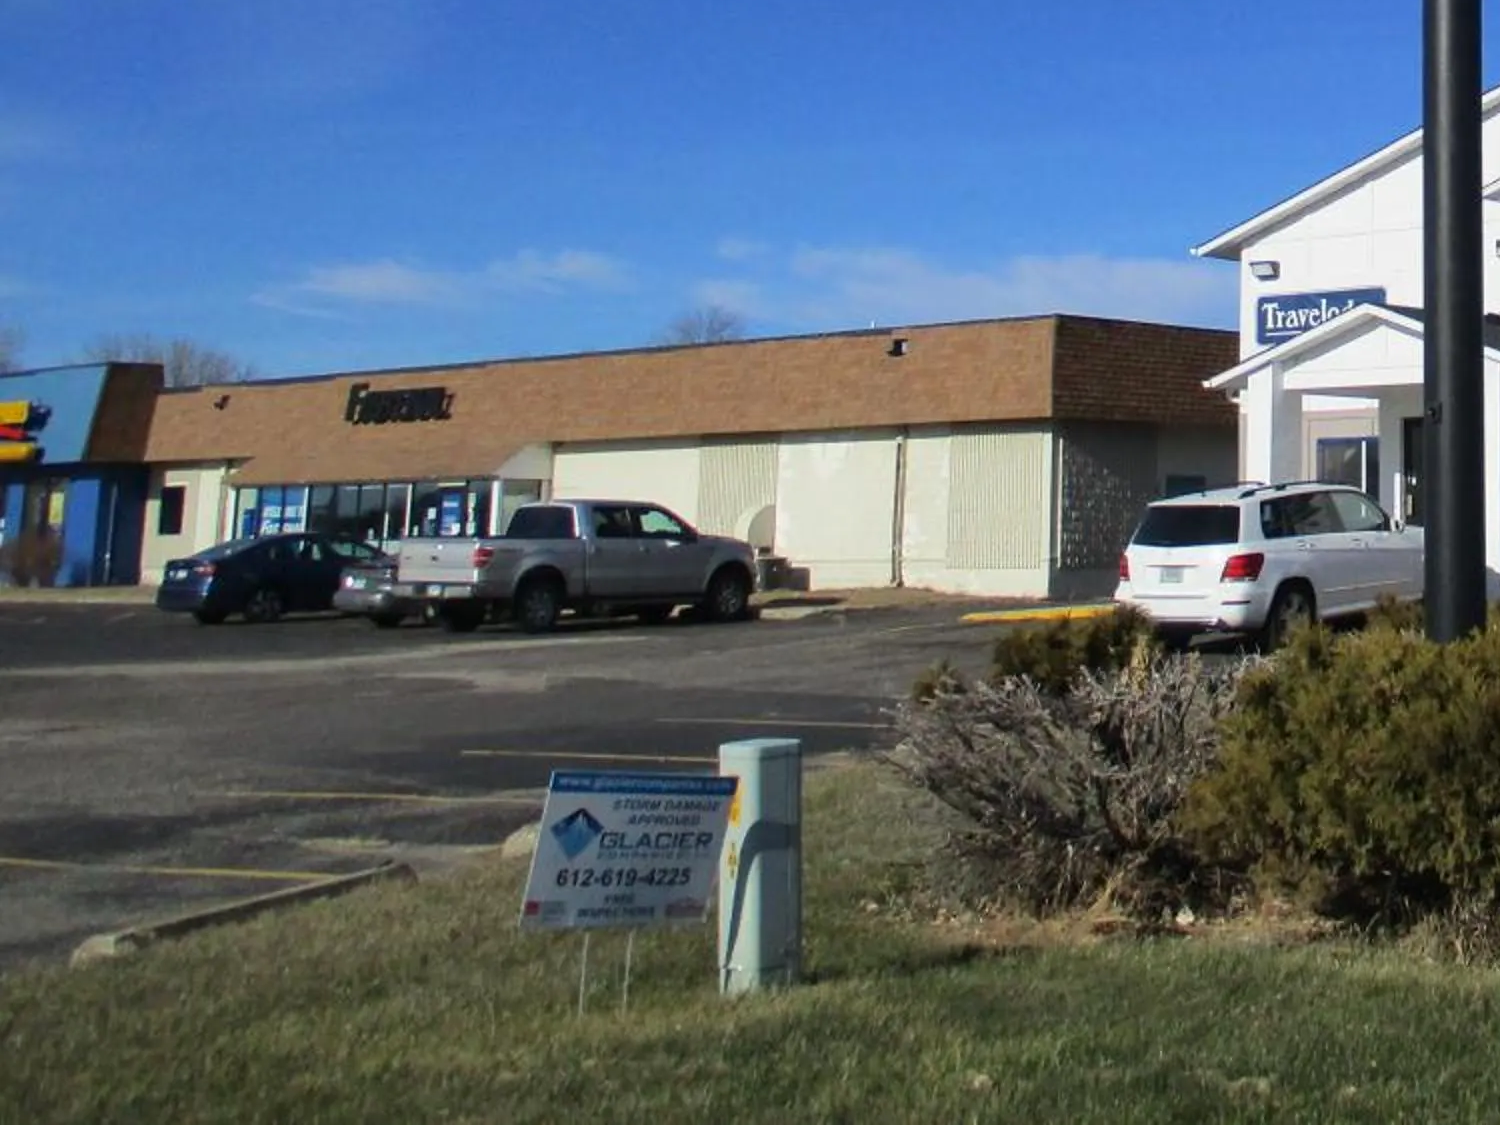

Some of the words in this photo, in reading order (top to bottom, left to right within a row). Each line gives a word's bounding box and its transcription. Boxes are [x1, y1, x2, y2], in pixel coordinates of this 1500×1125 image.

[612, 798, 662, 812] STORM
[664, 799, 722, 813] DAMAGE
[599, 831, 714, 850] GLACIER
[556, 867, 692, 888] 612-619-4225
